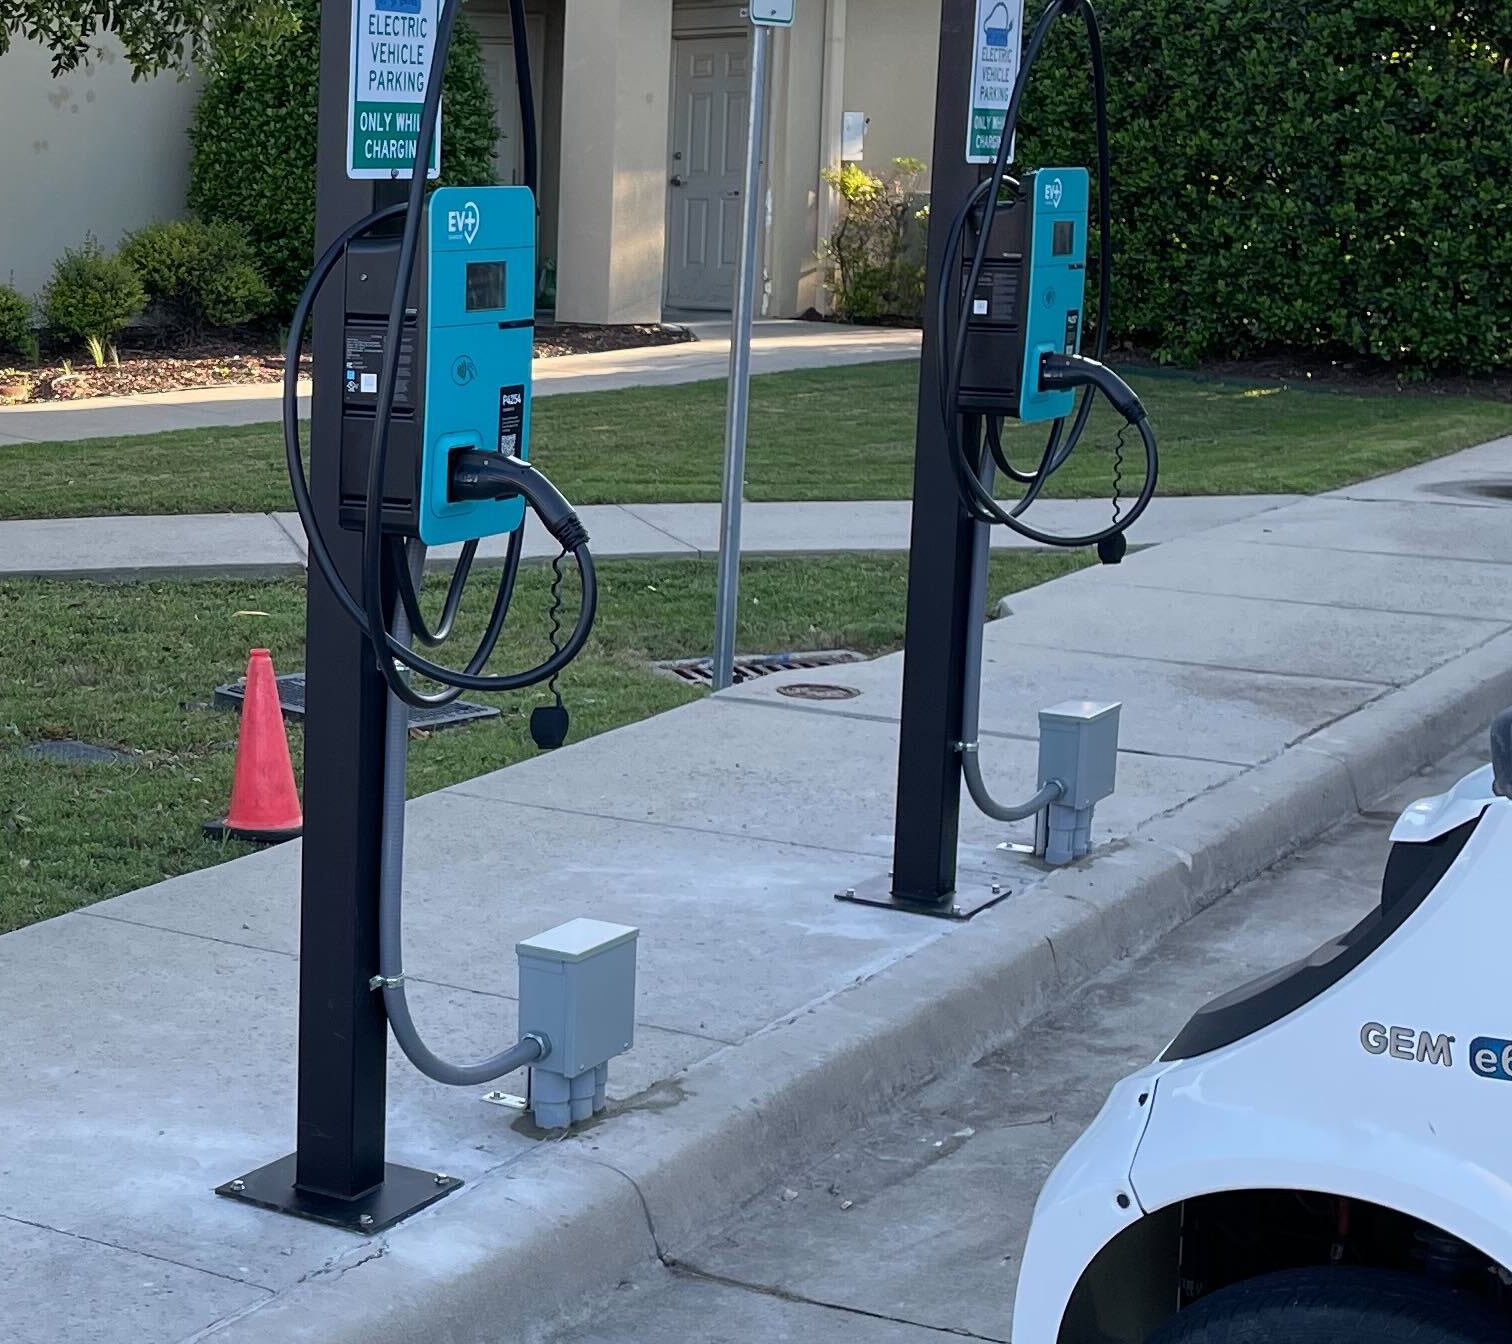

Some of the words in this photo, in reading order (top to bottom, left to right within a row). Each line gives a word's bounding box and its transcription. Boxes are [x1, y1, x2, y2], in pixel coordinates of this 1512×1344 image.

[368, 14, 428, 39] ELECTRIC
[371, 42, 424, 65] VEHICLE
[982, 47, 1013, 63] ELECTRIC
[369, 70, 424, 92] PARKING
[982, 67, 1010, 83] VEHICLE
[980, 86, 1009, 101] PARKING
[360, 112, 392, 132] ONLY
[396, 113, 421, 132] WHIL
[365, 139, 417, 159] CHARGIN
[1360, 1021, 1453, 1067] GEM
